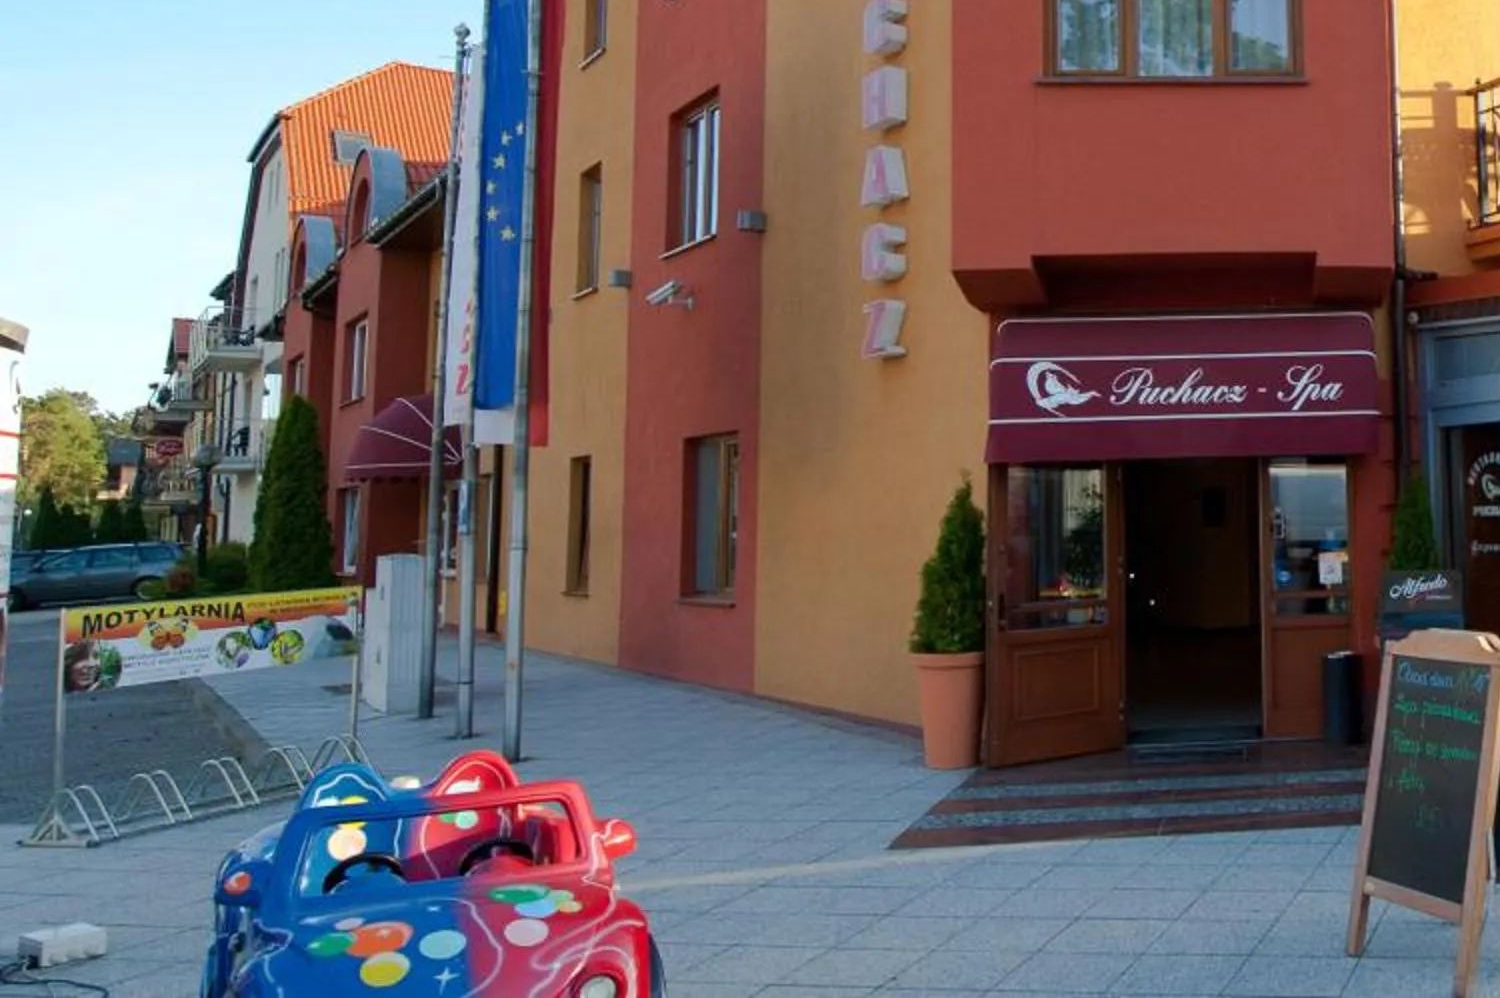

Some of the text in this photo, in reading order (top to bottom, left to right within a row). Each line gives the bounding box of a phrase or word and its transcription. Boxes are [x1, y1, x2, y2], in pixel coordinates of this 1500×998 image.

[1109, 367, 1248, 405] Puchacz
[1276, 363, 1344, 410] Spa
[81, 601, 246, 639] MOTYLARNIA
